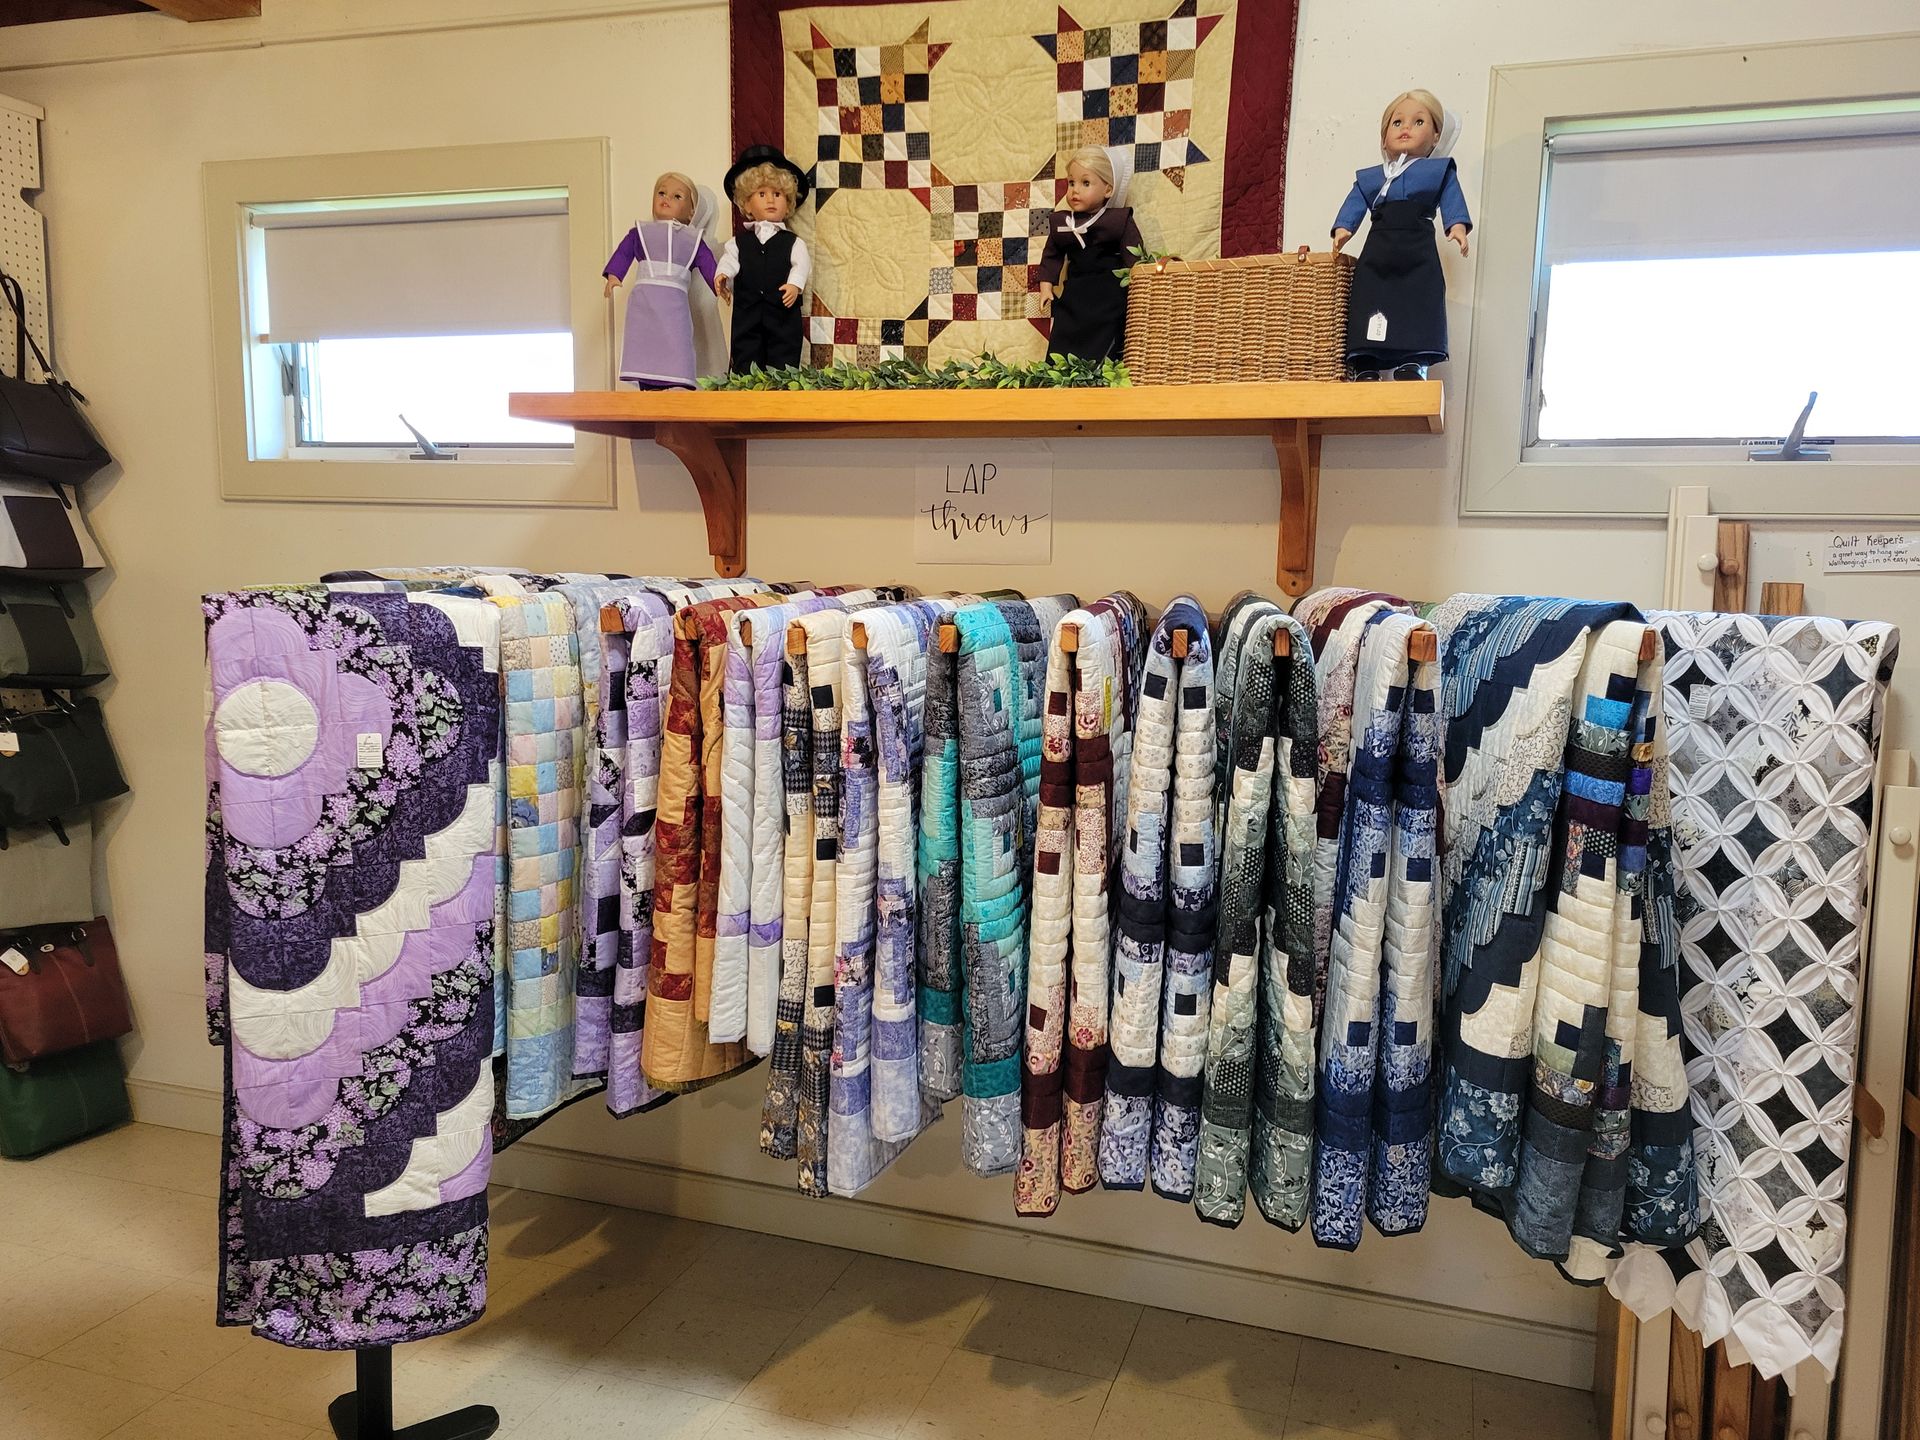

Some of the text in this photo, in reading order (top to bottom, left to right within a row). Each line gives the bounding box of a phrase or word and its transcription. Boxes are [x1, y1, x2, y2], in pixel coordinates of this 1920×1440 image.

[945, 463, 997, 495] LAP
[920, 499, 1049, 540] throws
[1833, 534, 1904, 548] Quilt Keeper's
[1877, 548, 1892, 558] hang
